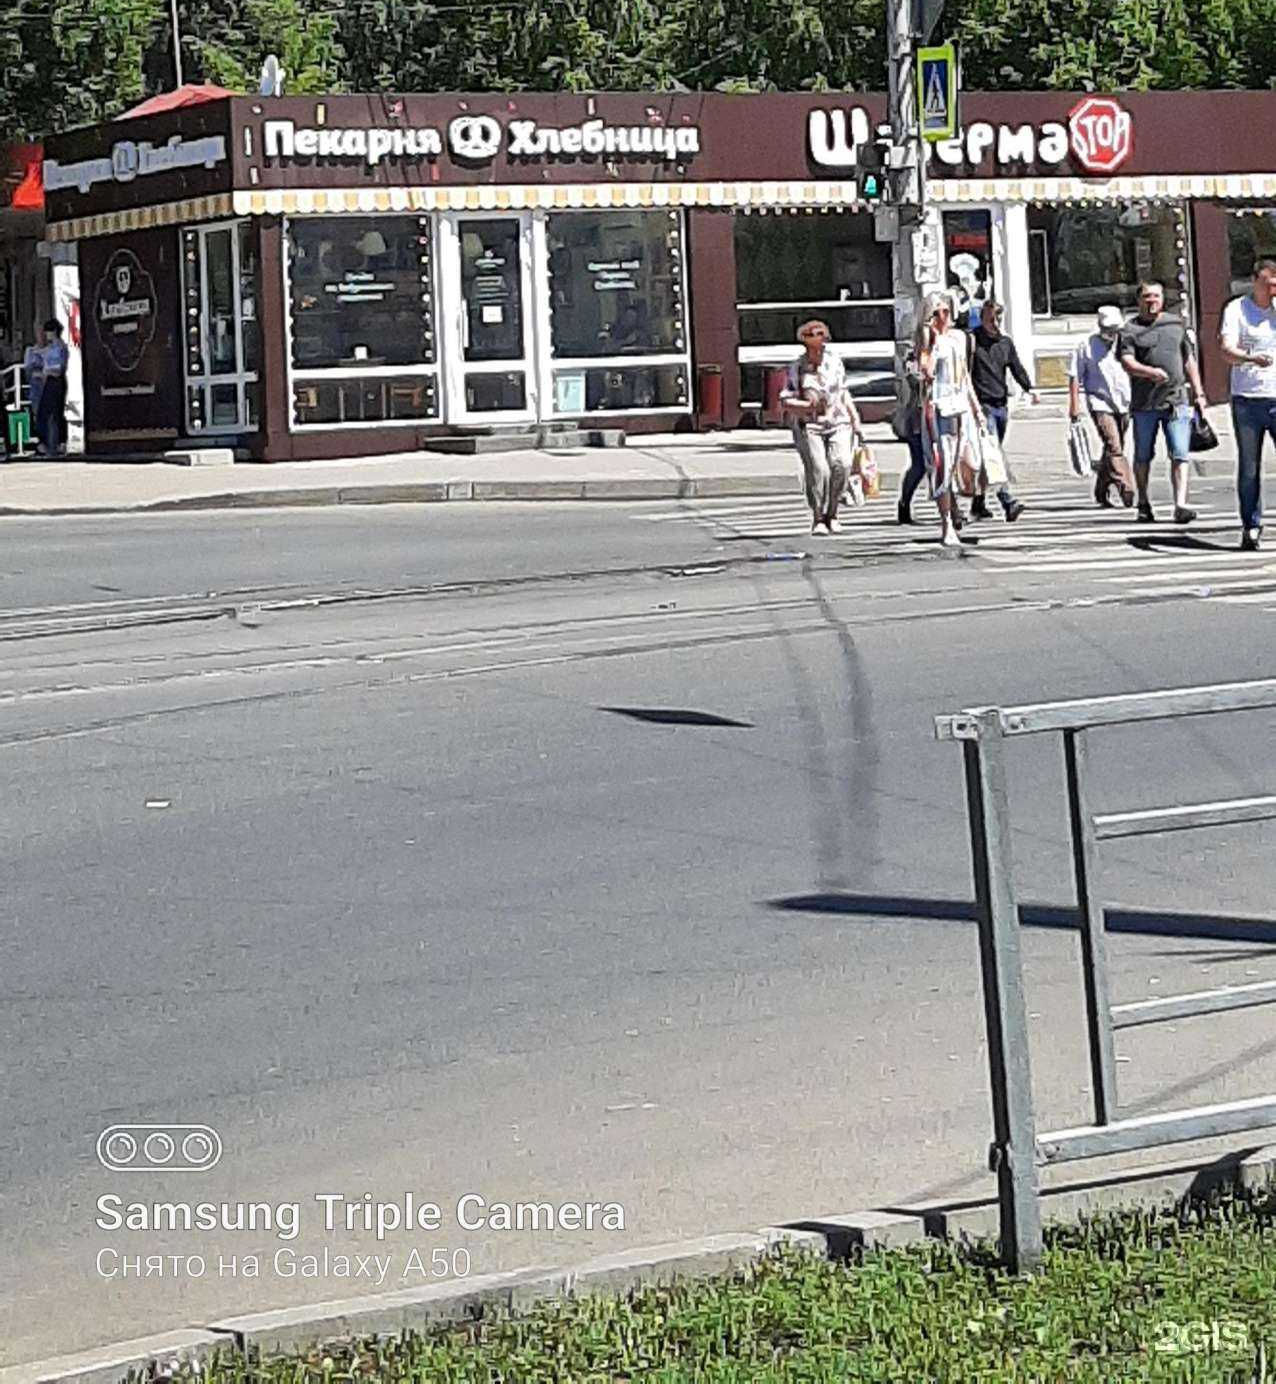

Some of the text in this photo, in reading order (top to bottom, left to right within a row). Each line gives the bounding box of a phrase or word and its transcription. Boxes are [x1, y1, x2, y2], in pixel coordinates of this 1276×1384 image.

[264, 121, 441, 164] Пекарня
[508, 120, 699, 159] Хлебница
[809, 107, 1068, 166] Шерма
[1070, 111, 1131, 162] STOP
